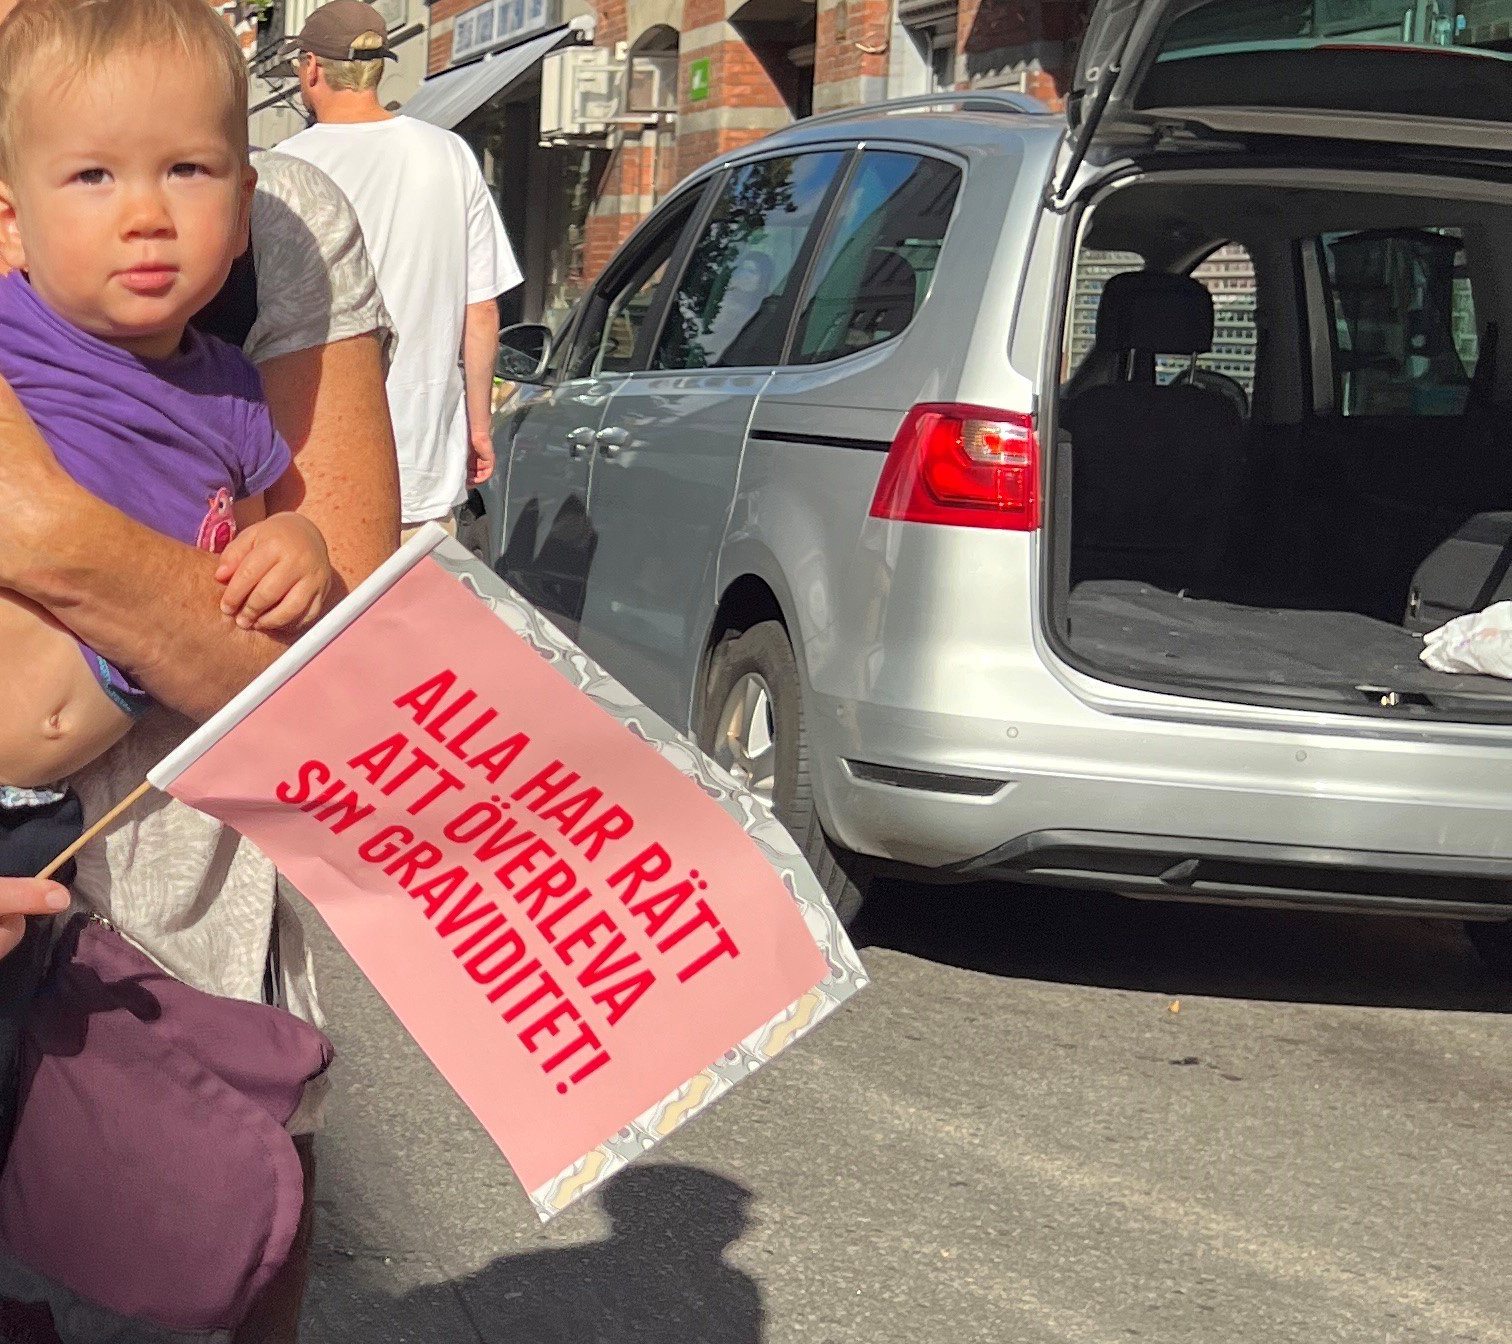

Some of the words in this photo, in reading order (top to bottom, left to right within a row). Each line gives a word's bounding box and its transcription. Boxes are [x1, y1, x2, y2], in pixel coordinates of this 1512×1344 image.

[274, 759, 378, 836] SIN
[357, 824, 612, 1096] GRAVIDITET!
[345, 732, 467, 817] ATT
[441, 794, 658, 1028] ÖVERLEVA
[393, 668, 532, 786] ALLA
[509, 758, 635, 863] HAR
[605, 841, 740, 984] RÄTT
